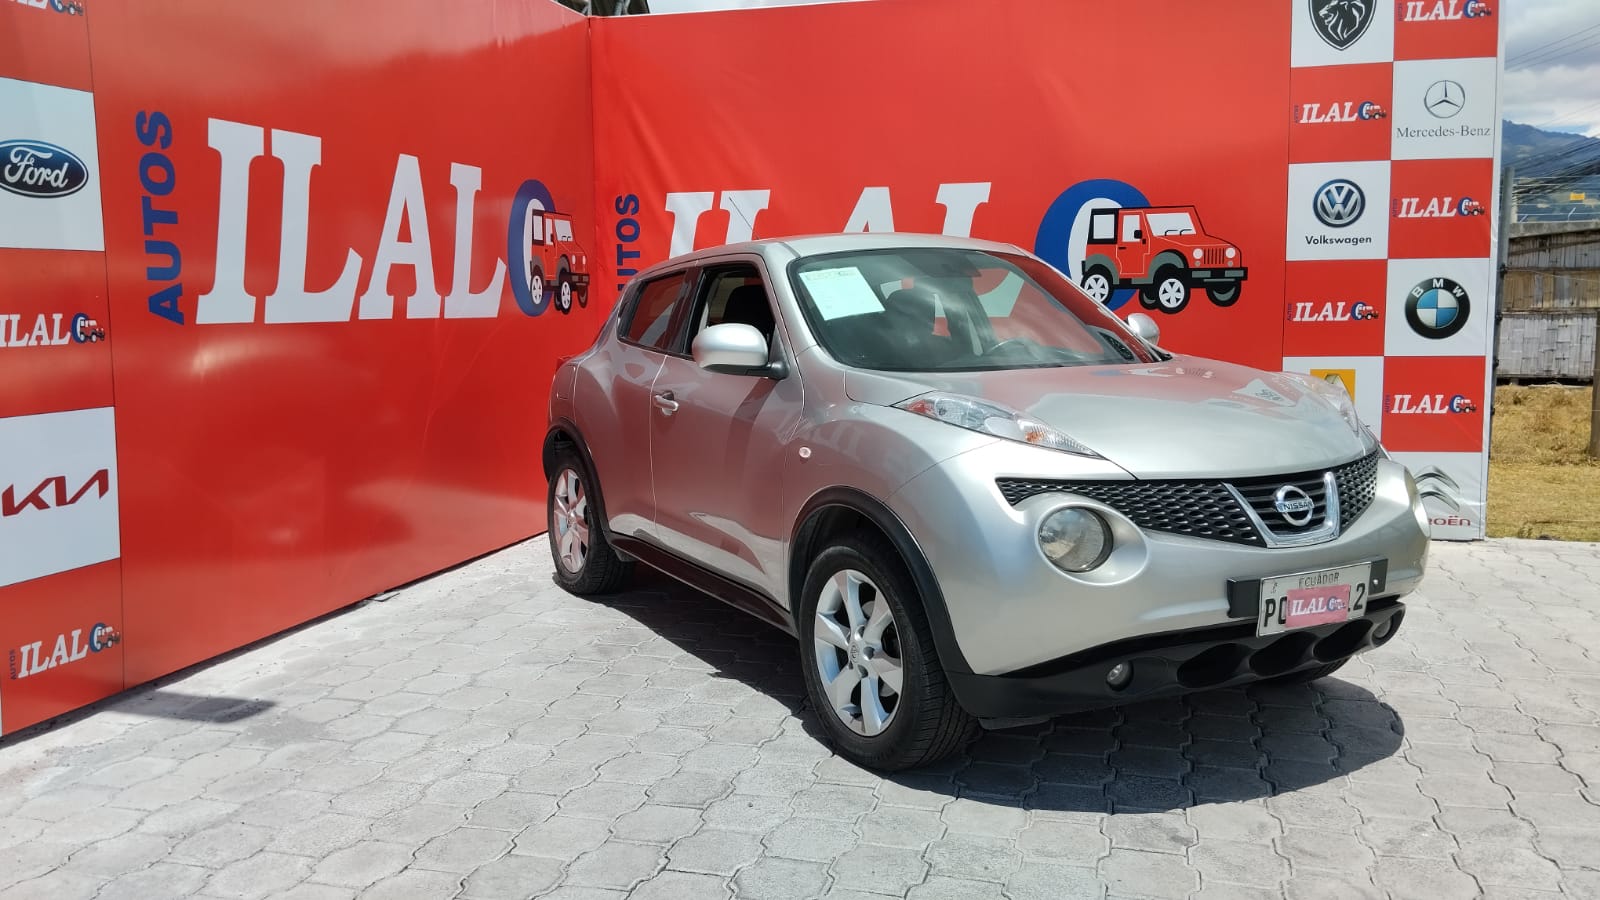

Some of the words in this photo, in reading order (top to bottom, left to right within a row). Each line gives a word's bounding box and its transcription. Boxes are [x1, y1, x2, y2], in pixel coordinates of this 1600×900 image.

[1396, 125, 1491, 138] Mercedes-Benz
[4, 146, 69, 188] Ford
[135, 110, 184, 325] AUTOS
[615, 194, 640, 291] TOS
[1305, 235, 1372, 246] Volkswagen
[1411, 278, 1465, 298] BMW
[2, 468, 109, 517] KIA
[1283, 500, 1313, 510] NISSAN
[1299, 572, 1340, 588] ECUADOR
